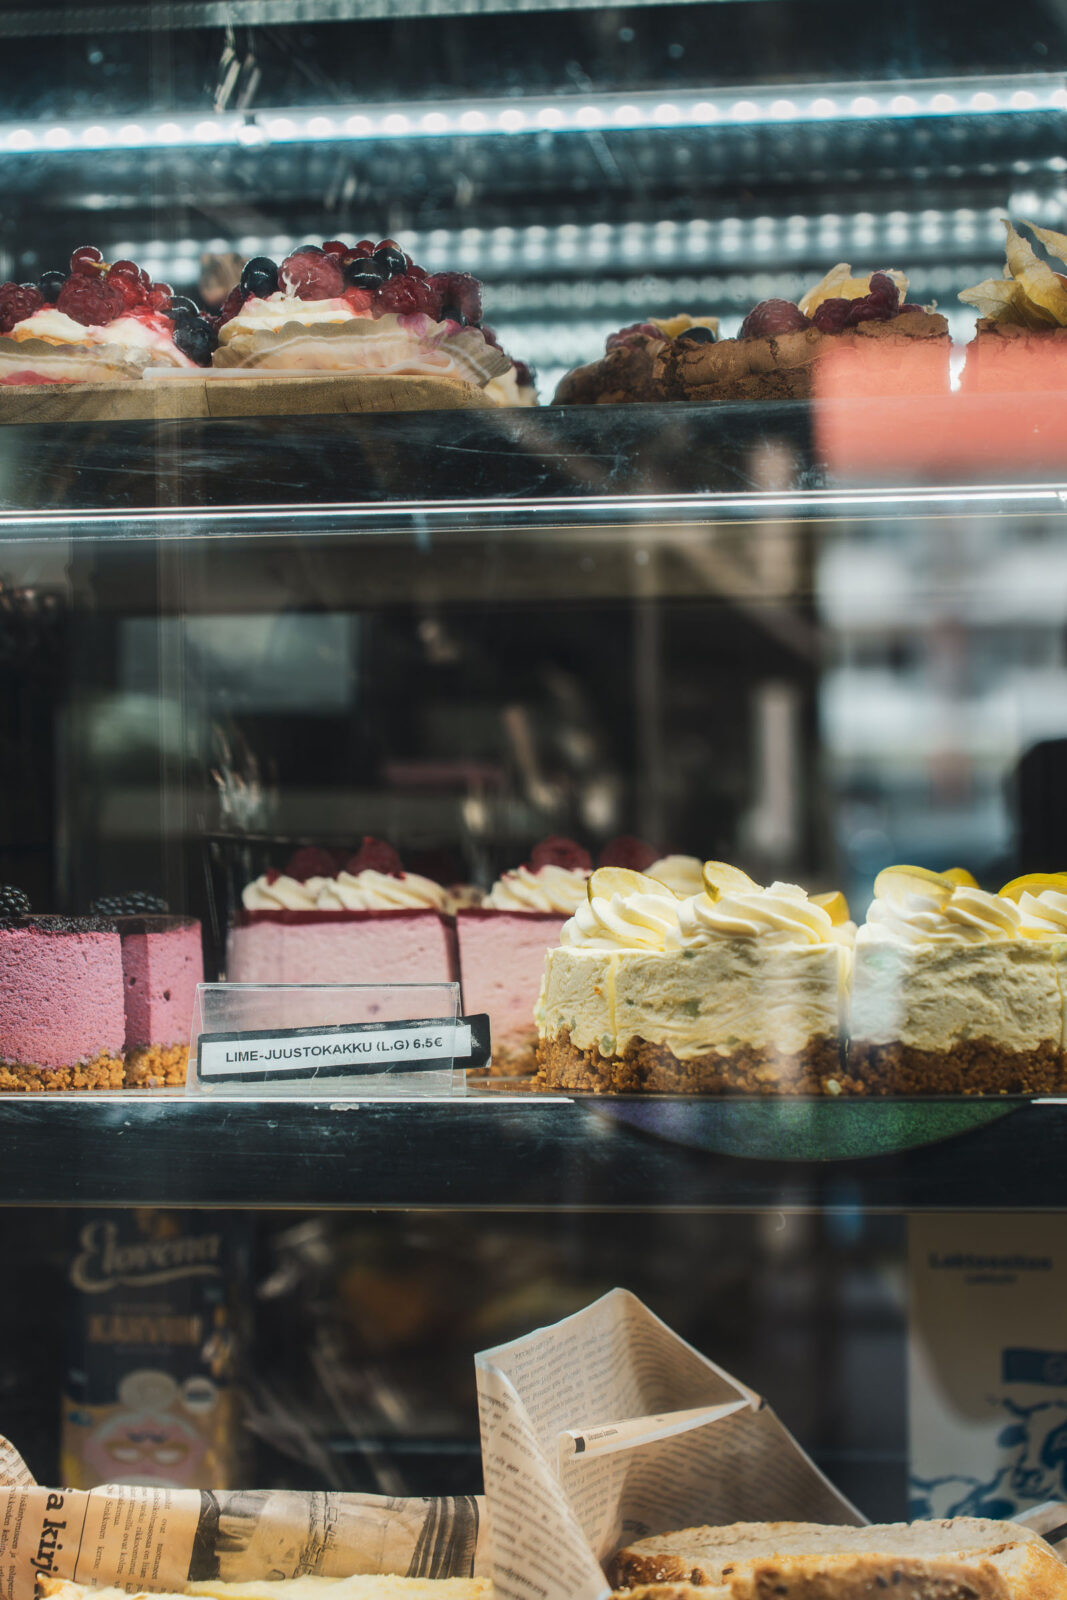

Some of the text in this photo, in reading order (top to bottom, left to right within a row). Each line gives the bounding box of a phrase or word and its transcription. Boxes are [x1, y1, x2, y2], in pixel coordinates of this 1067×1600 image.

[226, 1036, 443, 1063] LIME-JUUSTOKAKKU (L,G) 6,5€
